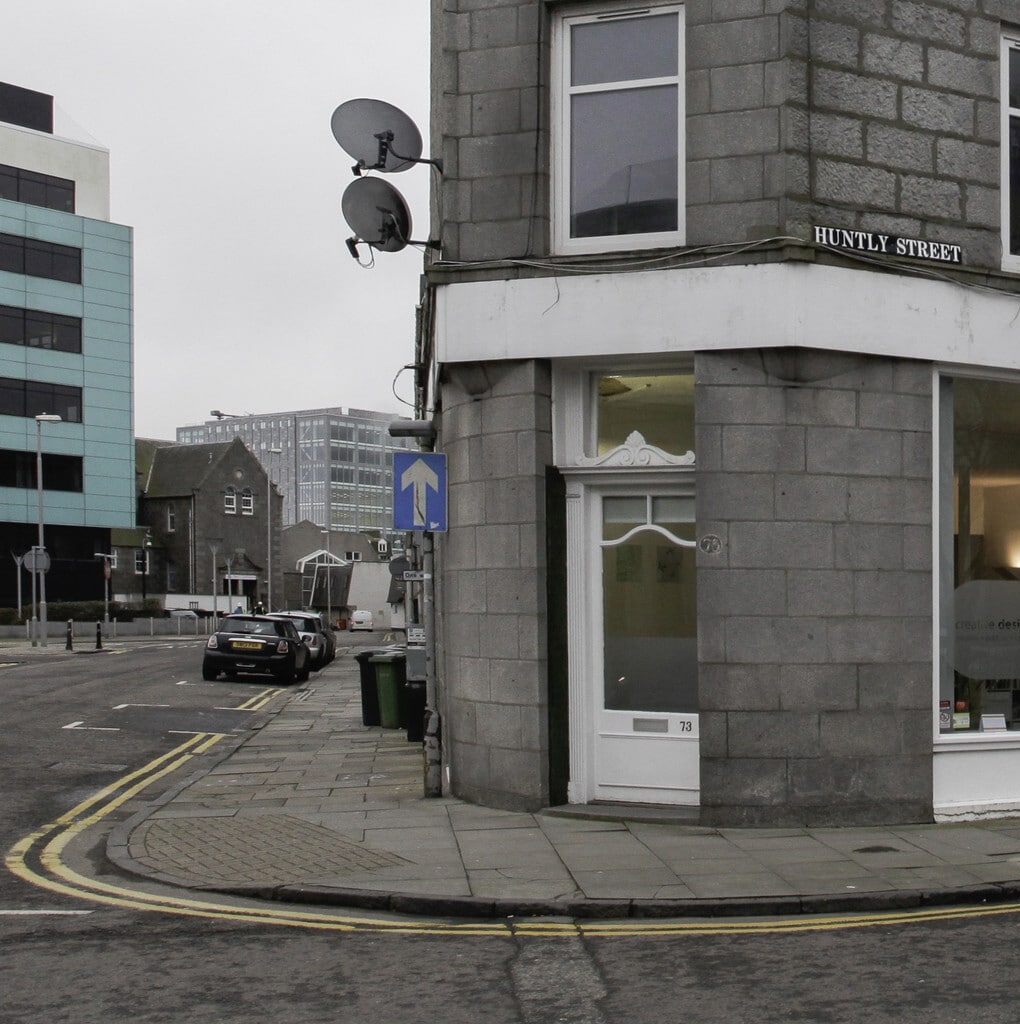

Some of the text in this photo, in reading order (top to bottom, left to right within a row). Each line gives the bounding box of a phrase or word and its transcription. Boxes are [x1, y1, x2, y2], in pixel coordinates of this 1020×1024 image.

[814, 226, 961, 263] HUNTLY STREET
[679, 721, 692, 732] 73
